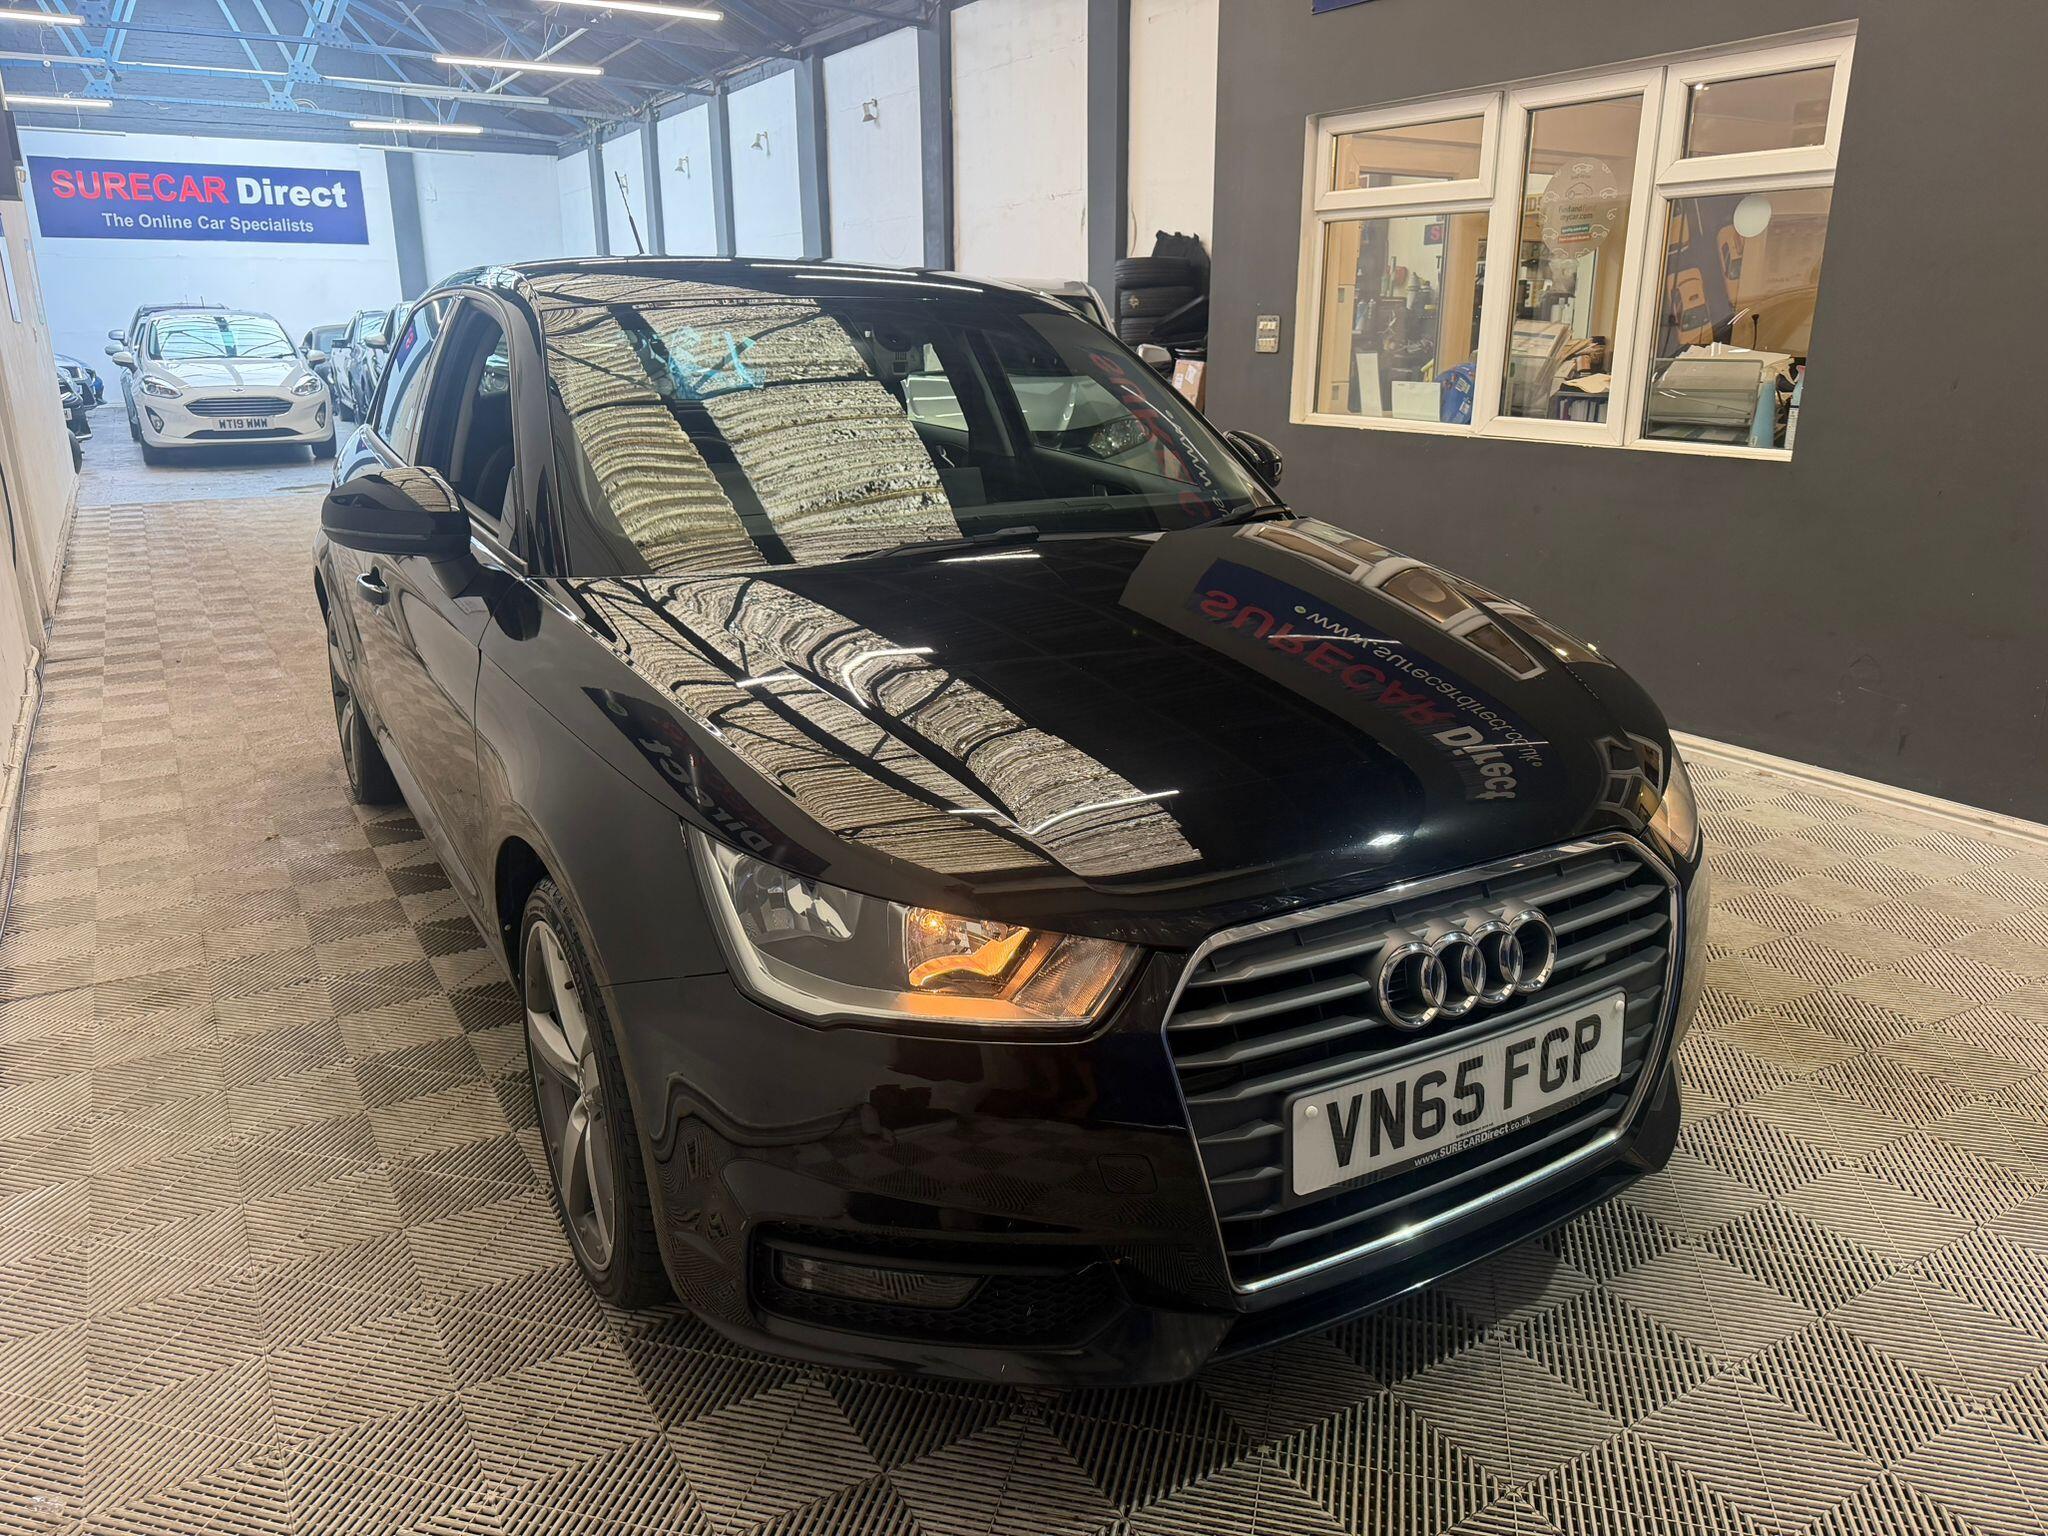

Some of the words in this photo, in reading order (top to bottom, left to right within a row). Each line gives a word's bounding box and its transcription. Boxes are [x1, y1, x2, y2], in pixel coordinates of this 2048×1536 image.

[51, 169, 229, 205] SURECAR
[237, 176, 348, 209] Direct
[102, 212, 134, 228] The
[139, 214, 192, 230] Online
[198, 215, 225, 231] Car
[230, 215, 314, 235] Specialists
[1326, 1055, 1486, 1168] VN65
[1503, 1014, 1602, 1111] FGP
[1414, 1115, 1531, 1167] www.SURECARDirect.co.uk
